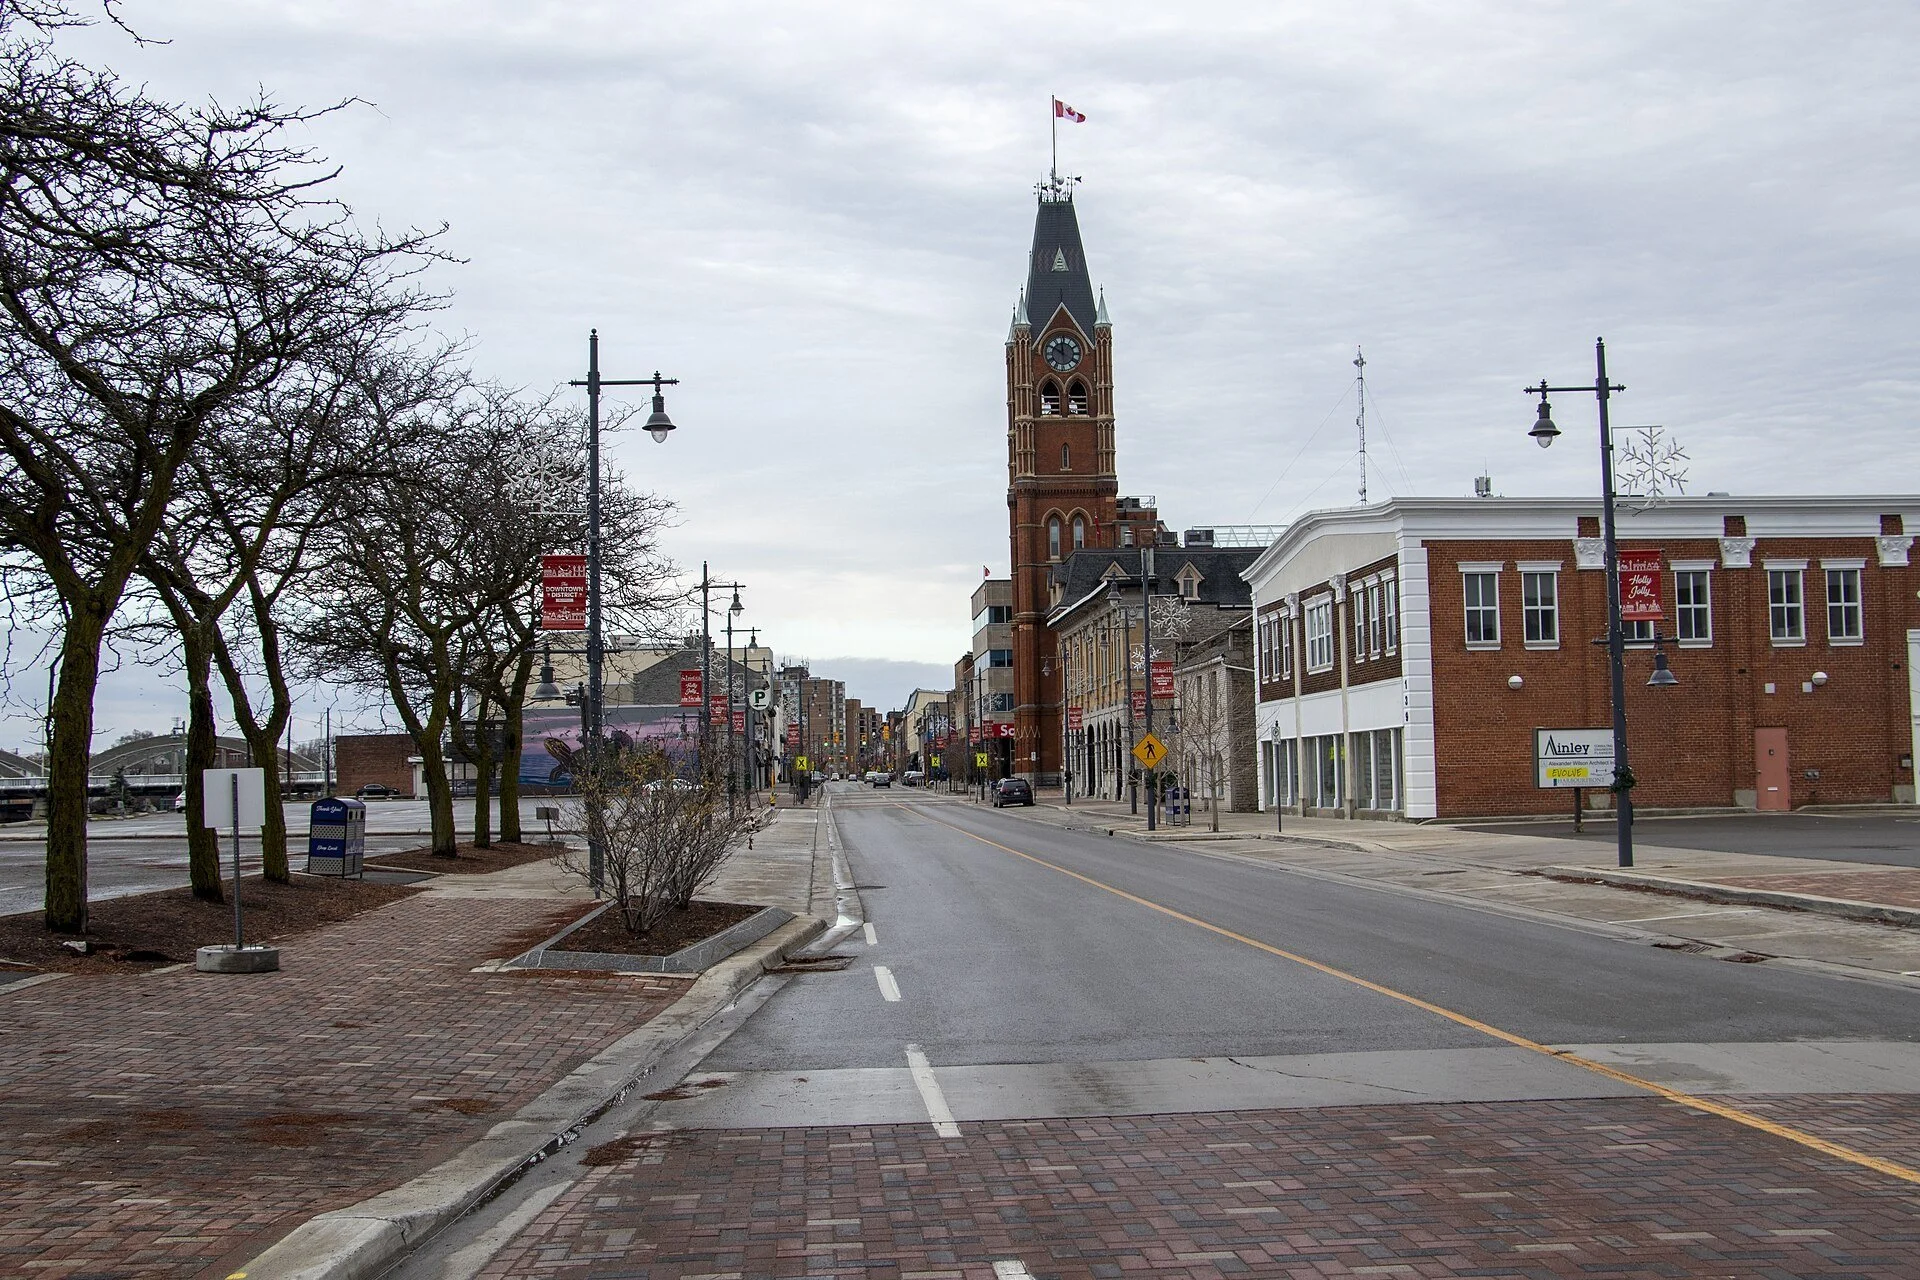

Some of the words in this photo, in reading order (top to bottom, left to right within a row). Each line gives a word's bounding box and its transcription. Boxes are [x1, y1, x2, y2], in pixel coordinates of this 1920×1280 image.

[1629, 574, 1652, 585] Holly
[1628, 586, 1656, 598] Jolly
[755, 692, 766, 703] P
[1544, 734, 1590, 755] Ainley
[1552, 769, 1582, 777] EVOLVE
